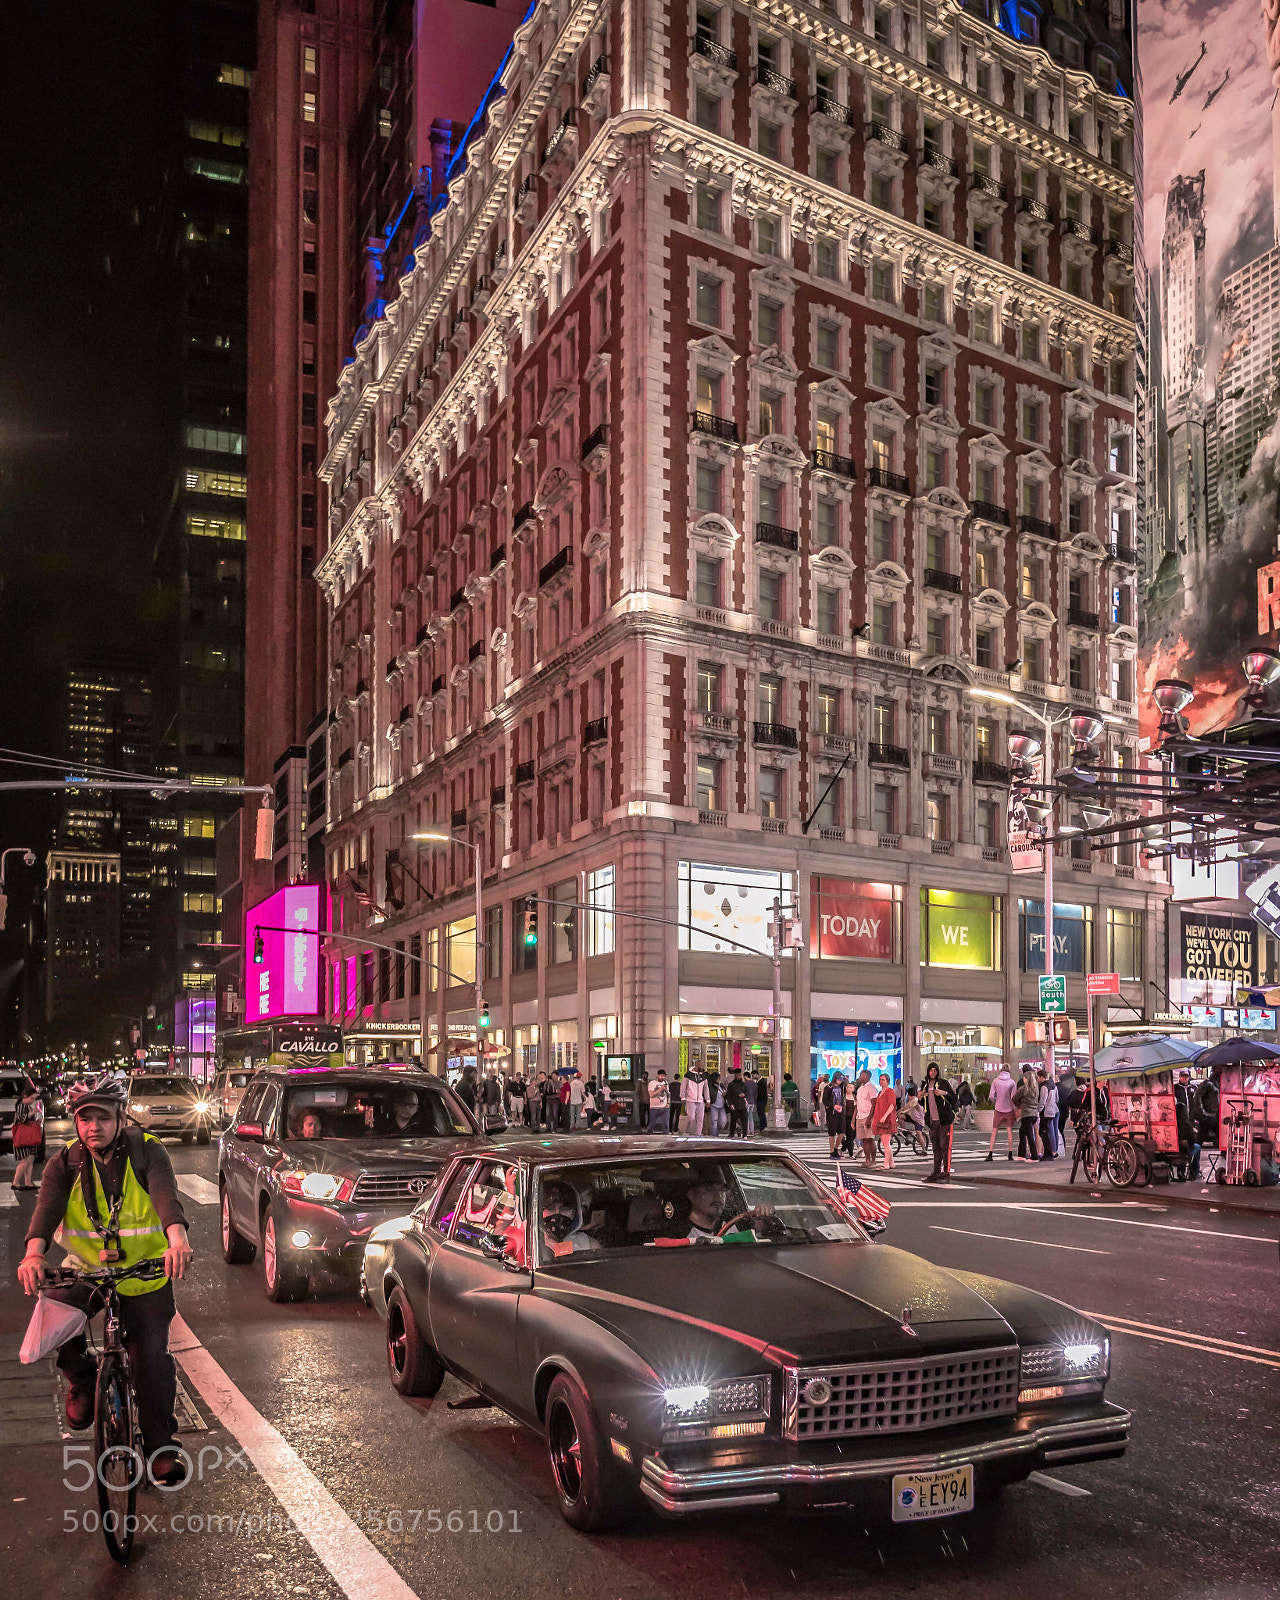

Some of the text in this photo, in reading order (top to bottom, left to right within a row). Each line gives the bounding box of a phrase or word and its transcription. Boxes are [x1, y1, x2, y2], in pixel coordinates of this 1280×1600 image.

[820, 914, 882, 938] TODAY
[941, 924, 969, 946] WE
[1186, 924, 1253, 943] NEW YORK CITY
[1186, 940, 1252, 970] GOT YOU
[365, 1022, 421, 1031] KNICKERBOCKER
[279, 1041, 339, 1053] CAVALLO
[914, 1473, 955, 1484] New Jersey
